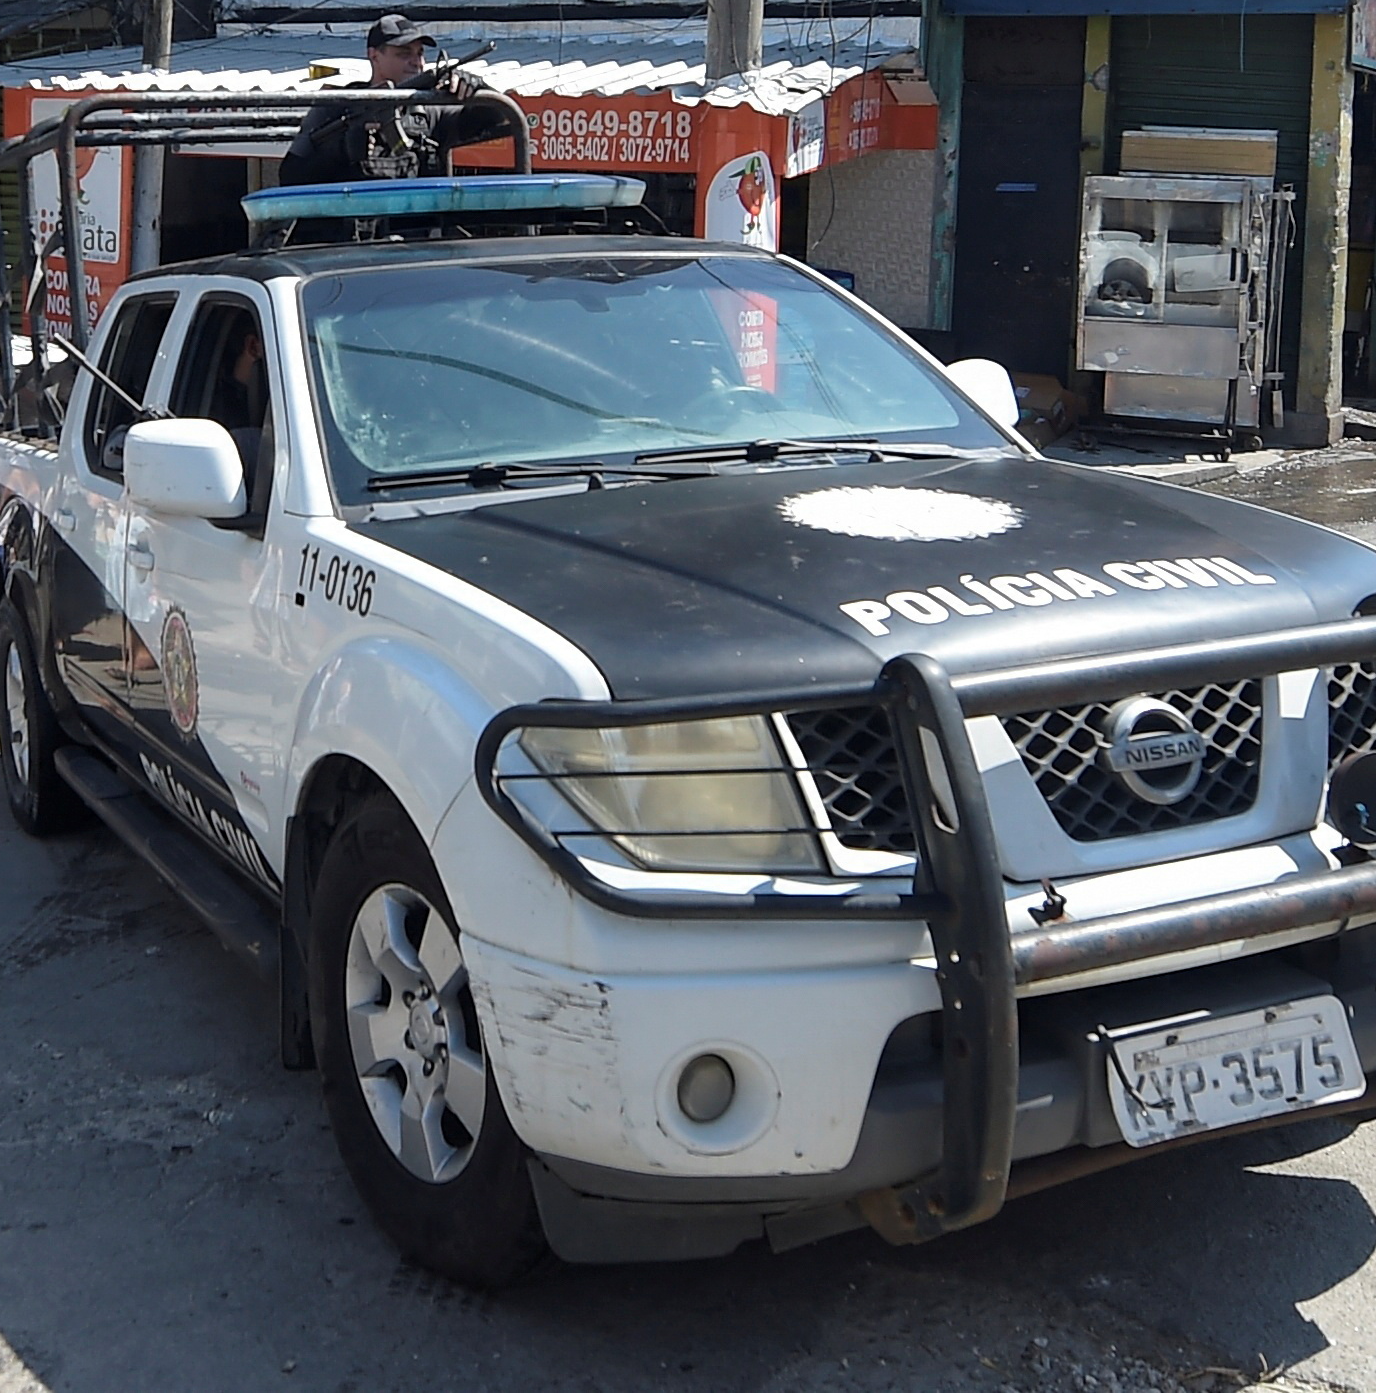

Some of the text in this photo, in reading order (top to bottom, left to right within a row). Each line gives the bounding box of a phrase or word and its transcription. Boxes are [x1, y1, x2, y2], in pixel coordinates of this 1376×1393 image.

[541, 109, 692, 138] 96649-8718
[541, 136, 609, 161] 3065-5402
[619, 138, 690, 163] 3072-9714
[298, 543, 376, 617] 11-0136
[838, 556, 1277, 638] POLÍCIA CIVIL
[1125, 738, 1200, 764] NISSAN
